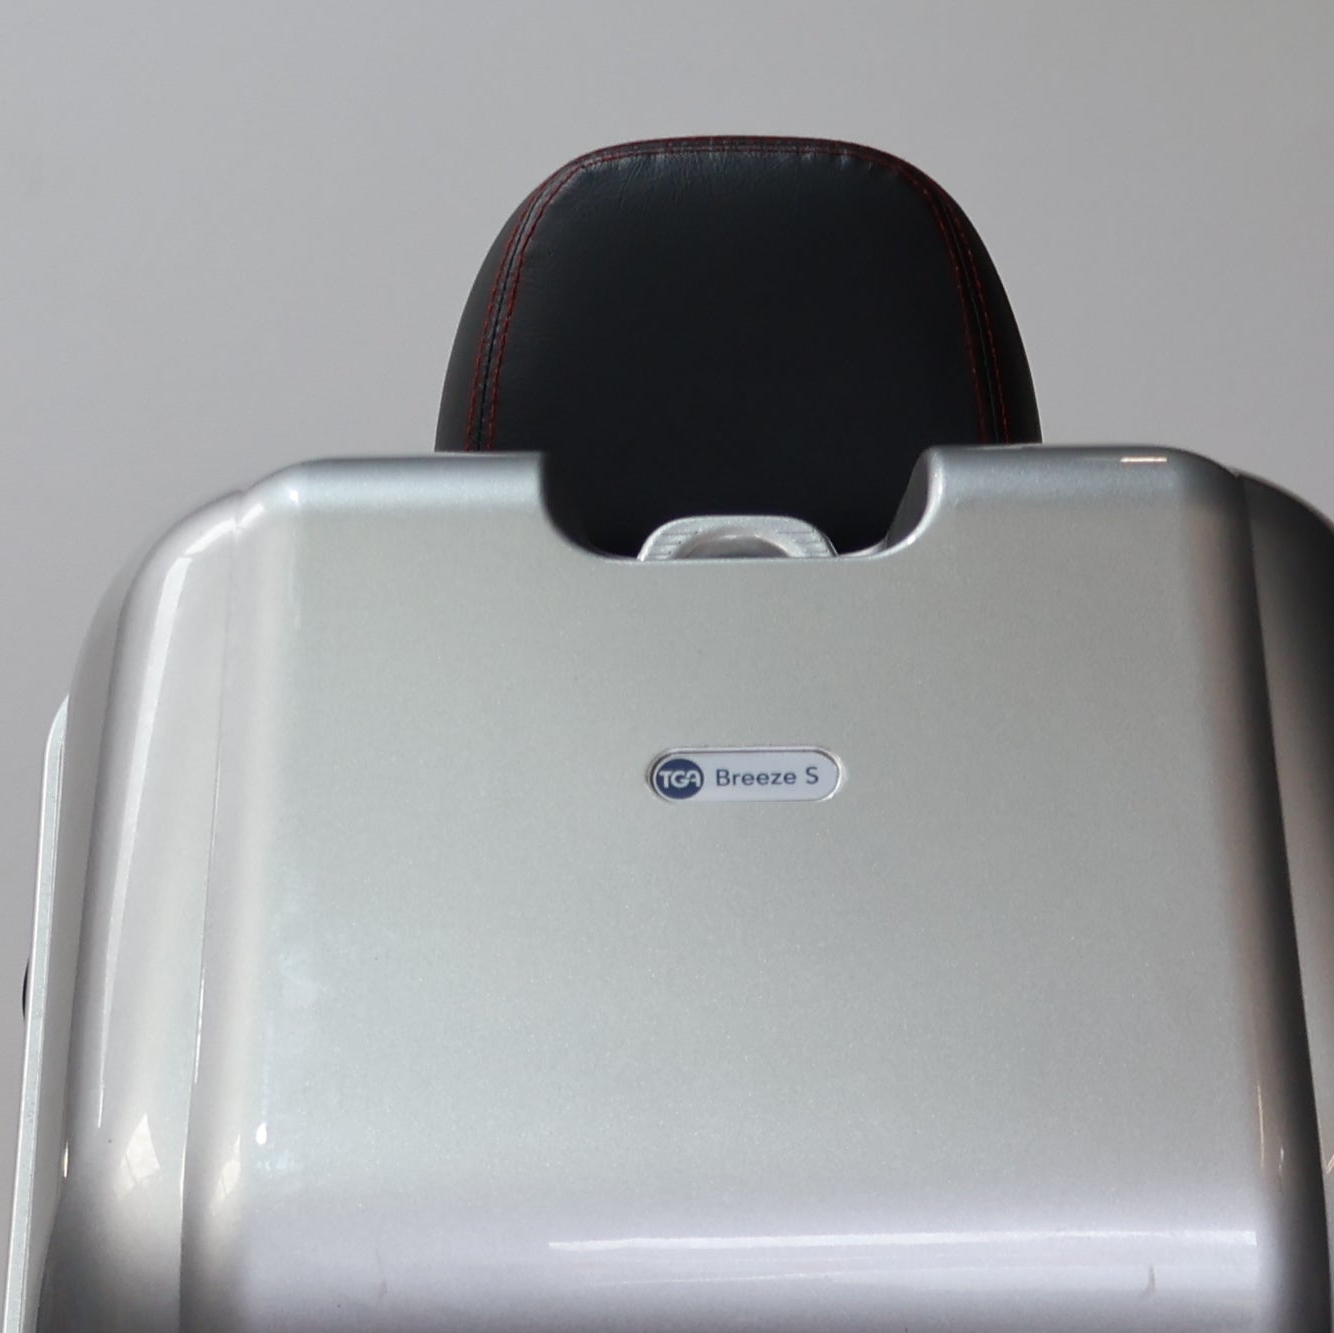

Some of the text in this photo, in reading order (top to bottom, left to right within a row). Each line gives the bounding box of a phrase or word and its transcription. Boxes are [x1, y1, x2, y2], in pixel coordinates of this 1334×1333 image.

[659, 770, 701, 788] TGA
[716, 766, 819, 787] Breeze S
